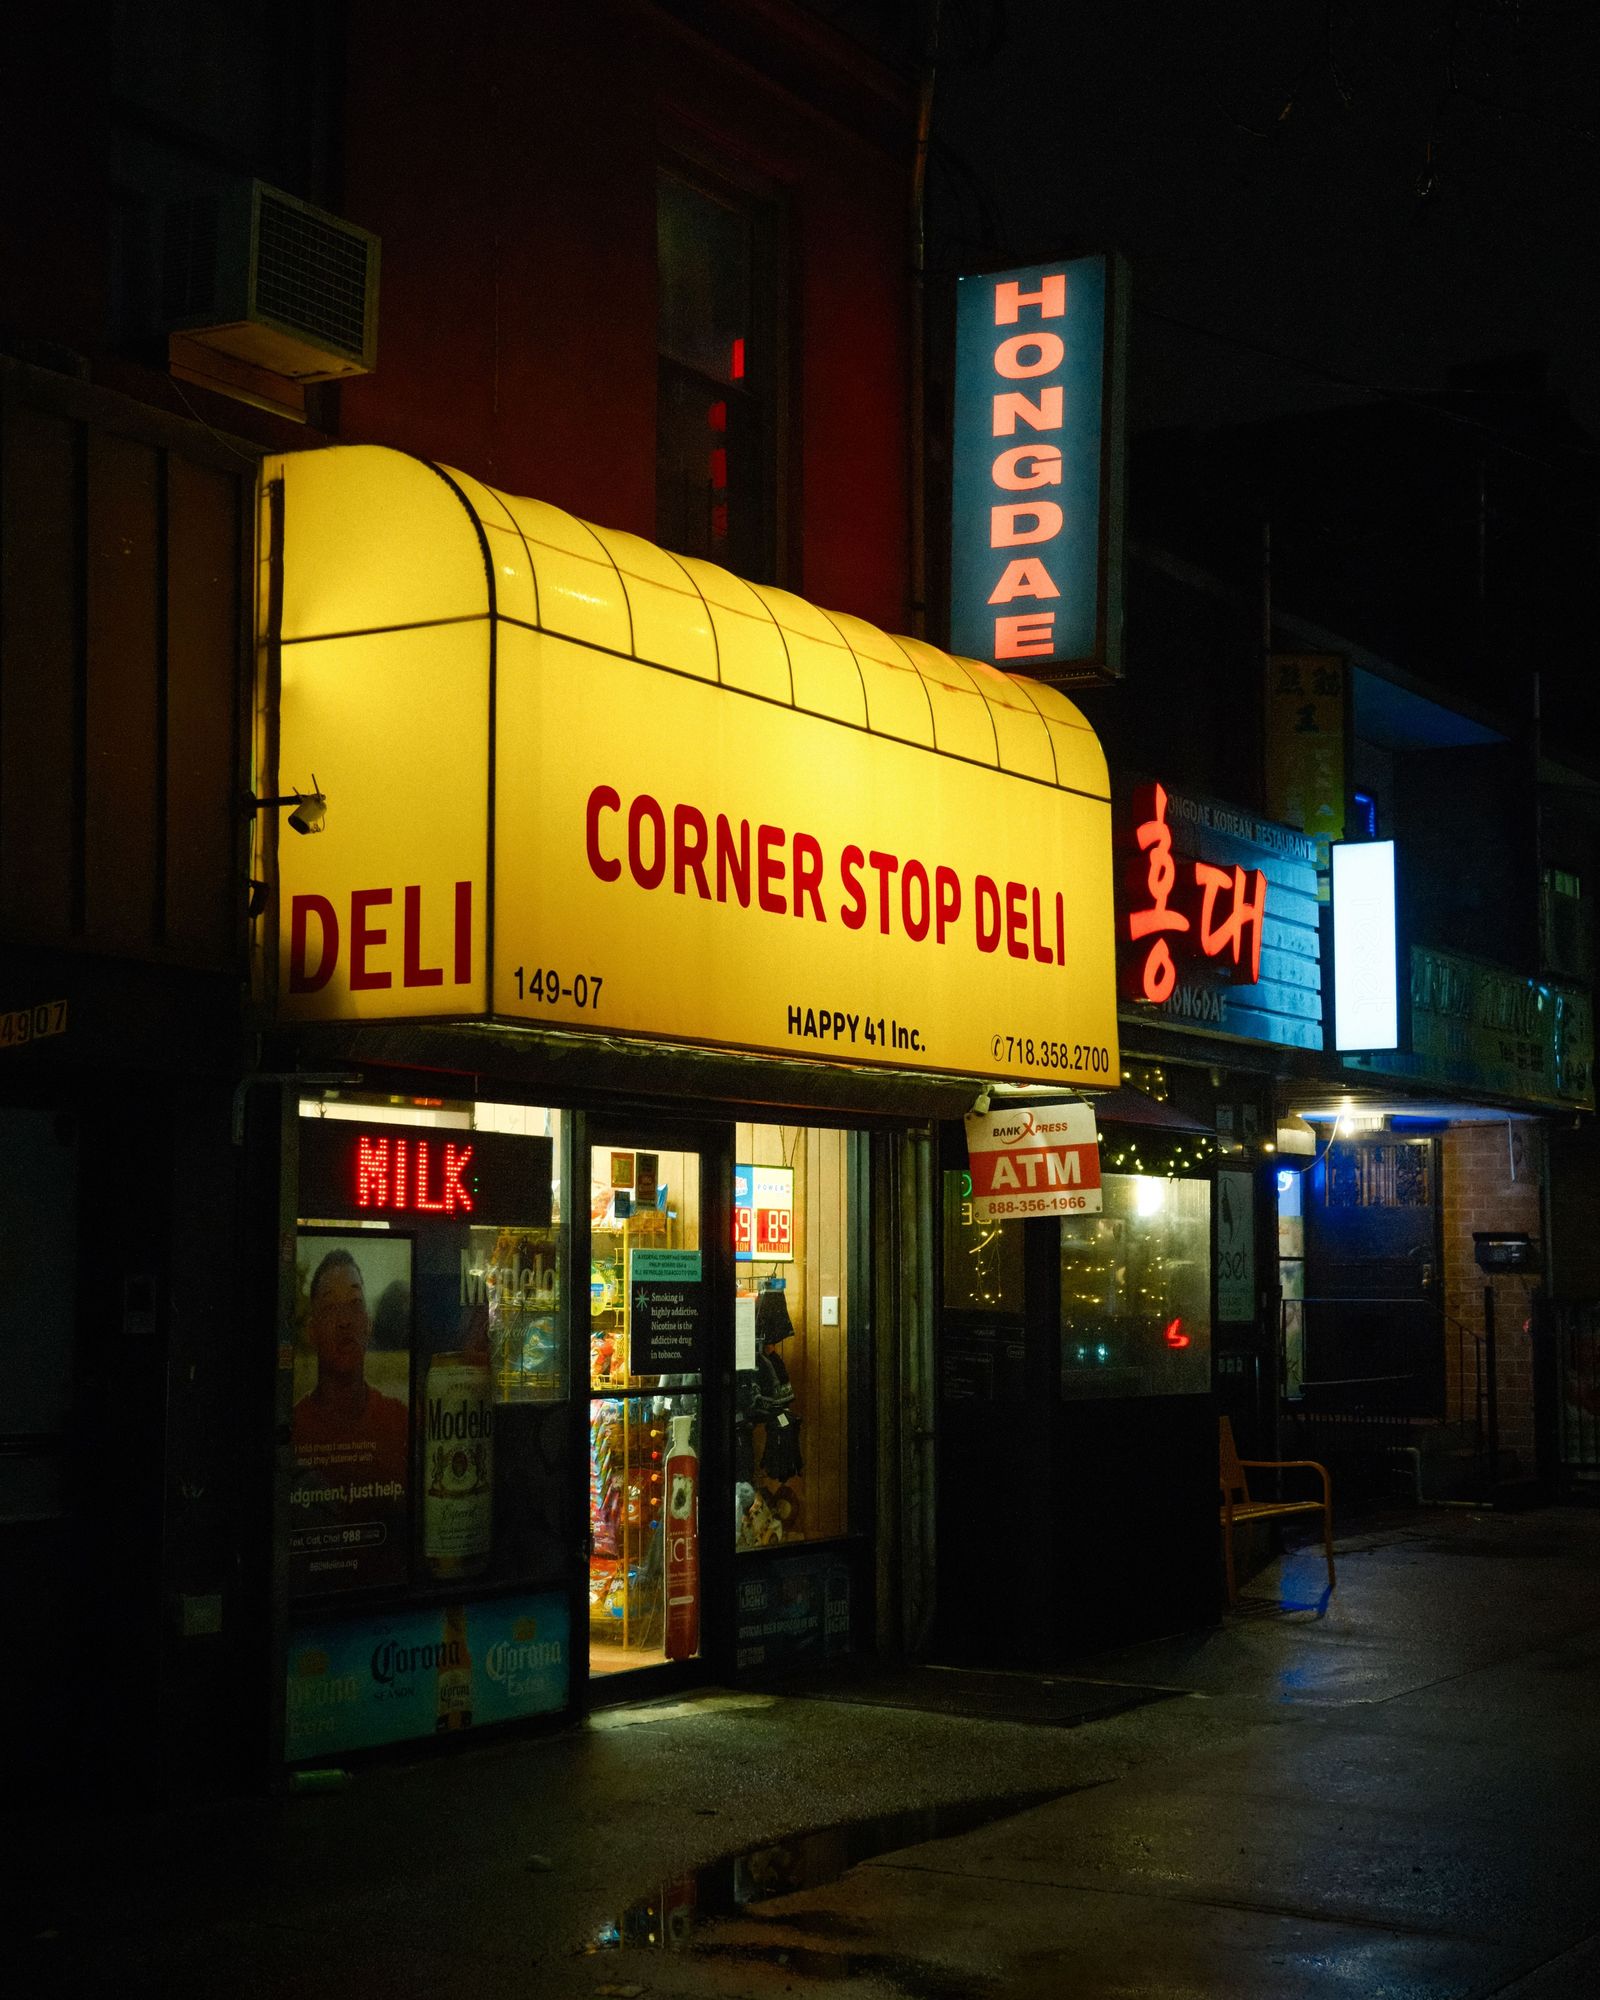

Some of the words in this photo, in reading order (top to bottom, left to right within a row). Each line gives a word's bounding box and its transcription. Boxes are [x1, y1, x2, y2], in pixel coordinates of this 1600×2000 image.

[988, 274, 1066, 660] HONGDAE
[1212, 810, 1252, 840] KOREAN
[1255, 825, 1312, 860] RESTAURANT
[586, 785, 828, 922] CORNER
[840, 844, 962, 944] STOP
[975, 874, 1066, 966] DELI
[1129, 782, 1268, 1004] 홍대
[289, 881, 472, 994] DELI
[514, 966, 604, 1009] 149-07
[788, 1005, 860, 1043] HAPPY
[864, 1015, 886, 1046] 41
[891, 1019, 926, 1052] Inc.
[1006, 1036, 1109, 1073] 718.358.2700
[358, 1136, 476, 1212] MILK
[991, 1151, 1082, 1190] ATM
[989, 1197, 1086, 1214] 888-356-1966
[758, 1243, 788, 1253] MILLION
[460, 1248, 557, 1307] Modelo
[651, 1292, 678, 1303] Smoking
[678, 1292, 684, 1301] is
[651, 1306, 670, 1319] highly
[671, 1306, 699, 1316] addictive.
[651, 1320, 677, 1331] Nicotine
[678, 1321, 683, 1330] is
[683, 1321, 692, 1330] the
[650, 1350, 658, 1359] in
[658, 1350, 682, 1360] tobacco.
[651, 1335, 678, 1345] addictive
[679, 1335, 692, 1347] drug
[428, 1398, 492, 1441] Modelo
[349, 1481, 373, 1505] just
[374, 1479, 405, 1502] help.
[342, 1528, 361, 1543] 988
[669, 1537, 693, 1562] ICE
[371, 1639, 461, 1688] Corona
[486, 1640, 562, 1686] Corona
